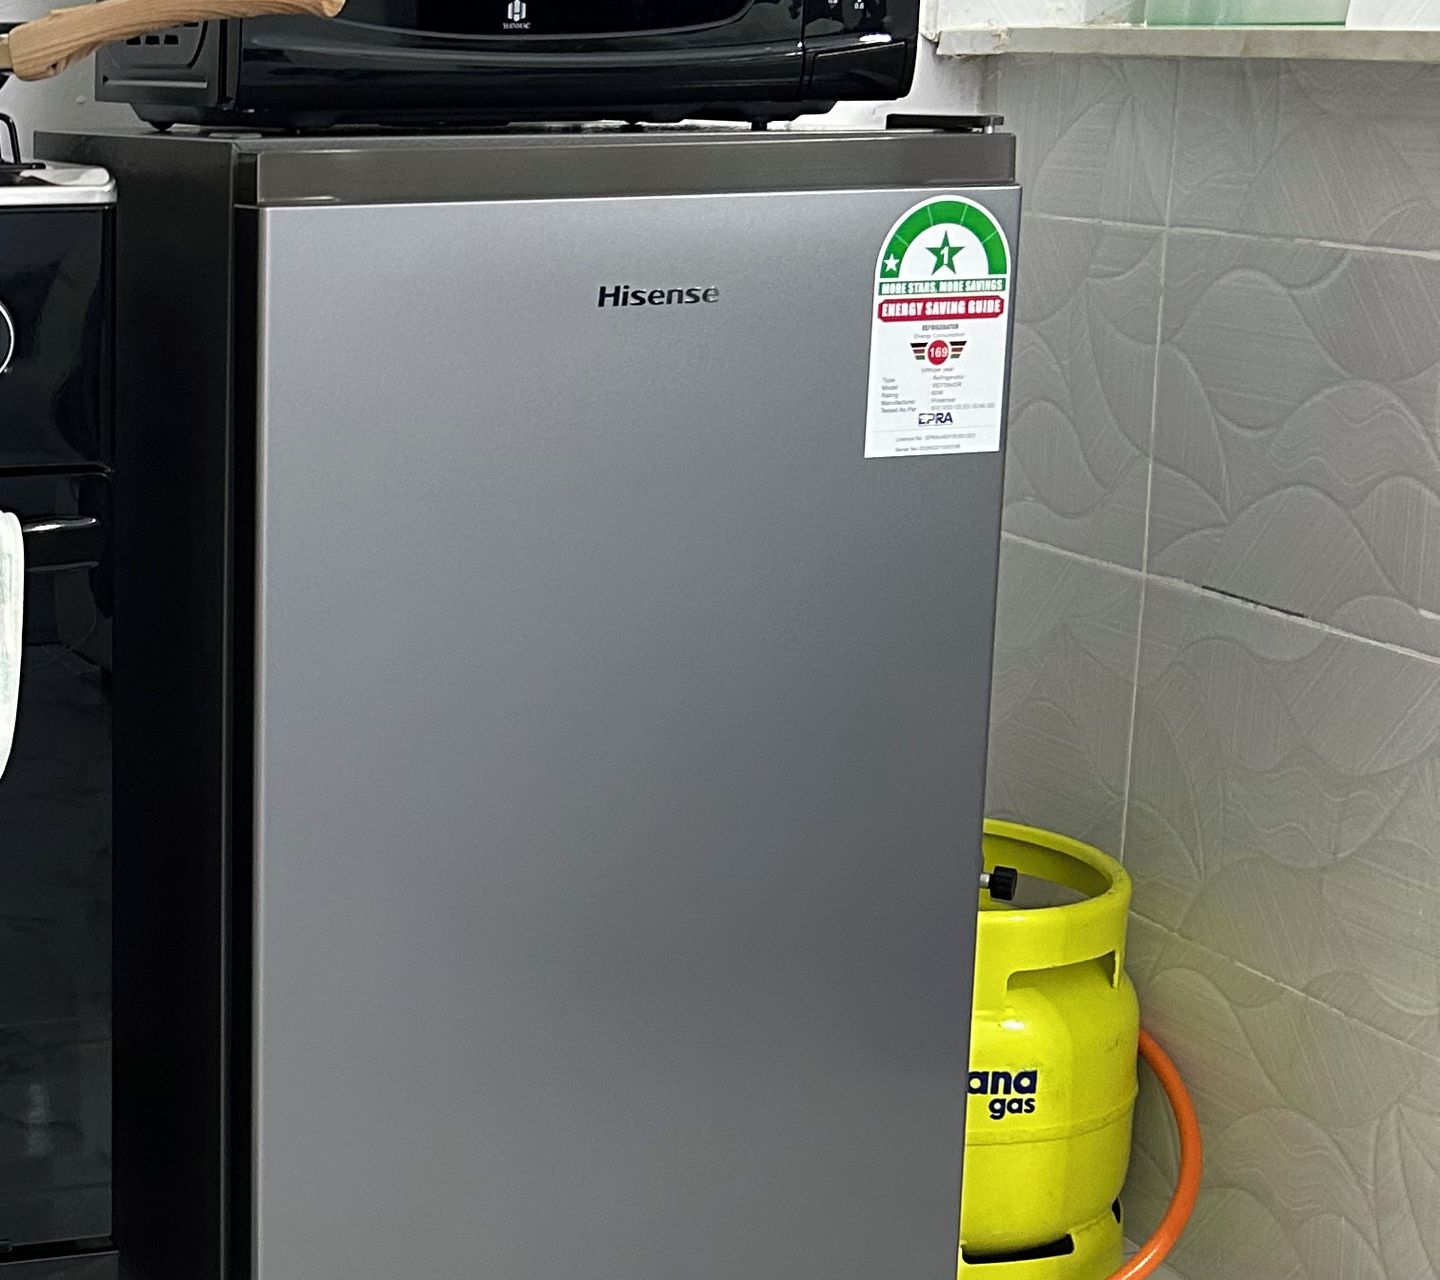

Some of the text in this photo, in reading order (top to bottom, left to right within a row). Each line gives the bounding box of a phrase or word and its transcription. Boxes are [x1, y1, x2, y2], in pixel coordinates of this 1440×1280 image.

[941, 246, 949, 264] 1
[881, 279, 1002, 294] MORE STARS, MORE SAVINGS
[598, 285, 720, 307] Hisense
[881, 299, 1001, 317] ENERGY SAVING GUIDE
[929, 347, 948, 358] 169
[919, 412, 953, 424] EPRA
[989, 1098, 1035, 1120] gas
